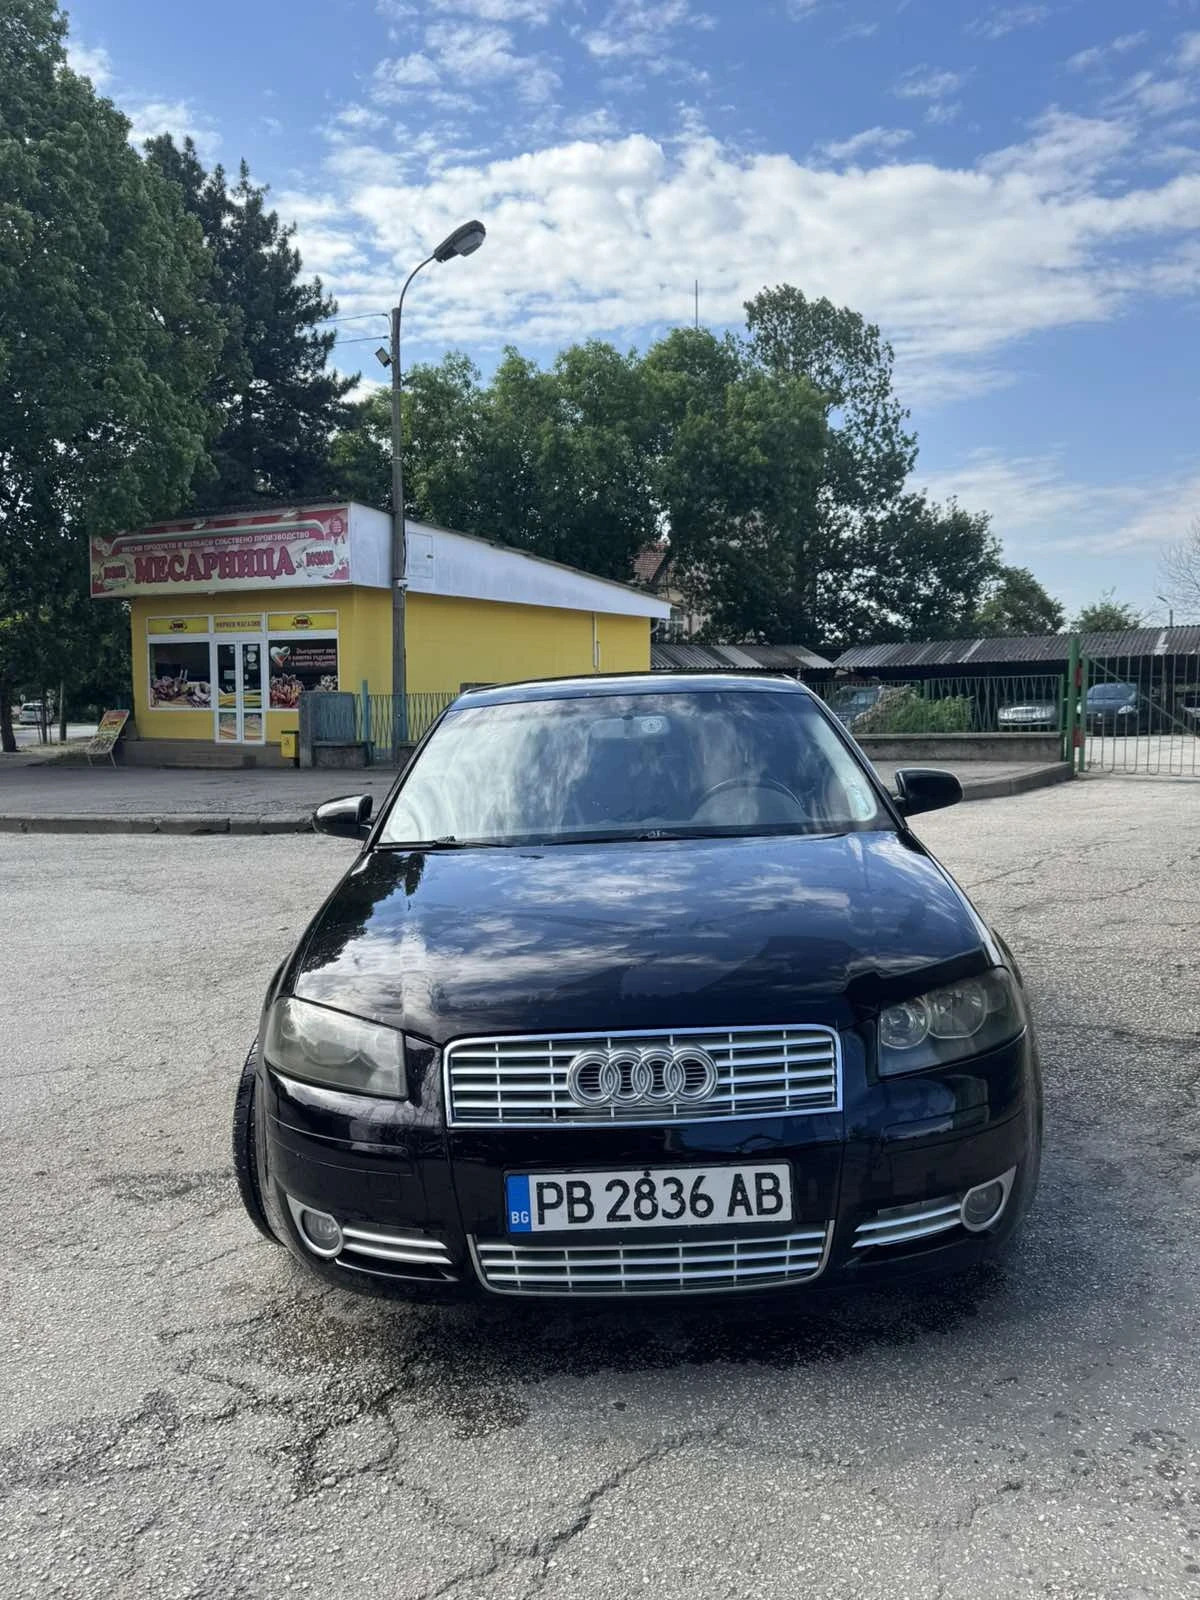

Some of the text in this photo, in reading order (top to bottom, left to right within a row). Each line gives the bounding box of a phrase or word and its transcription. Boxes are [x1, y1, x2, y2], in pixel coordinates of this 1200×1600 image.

[254, 531, 310, 542] ПРОИЗВОДСТВО
[134, 546, 297, 584] МЕСАРНИЦА
[535, 1172, 784, 1225] PB 2836 AB
[511, 1211, 529, 1225] BG
